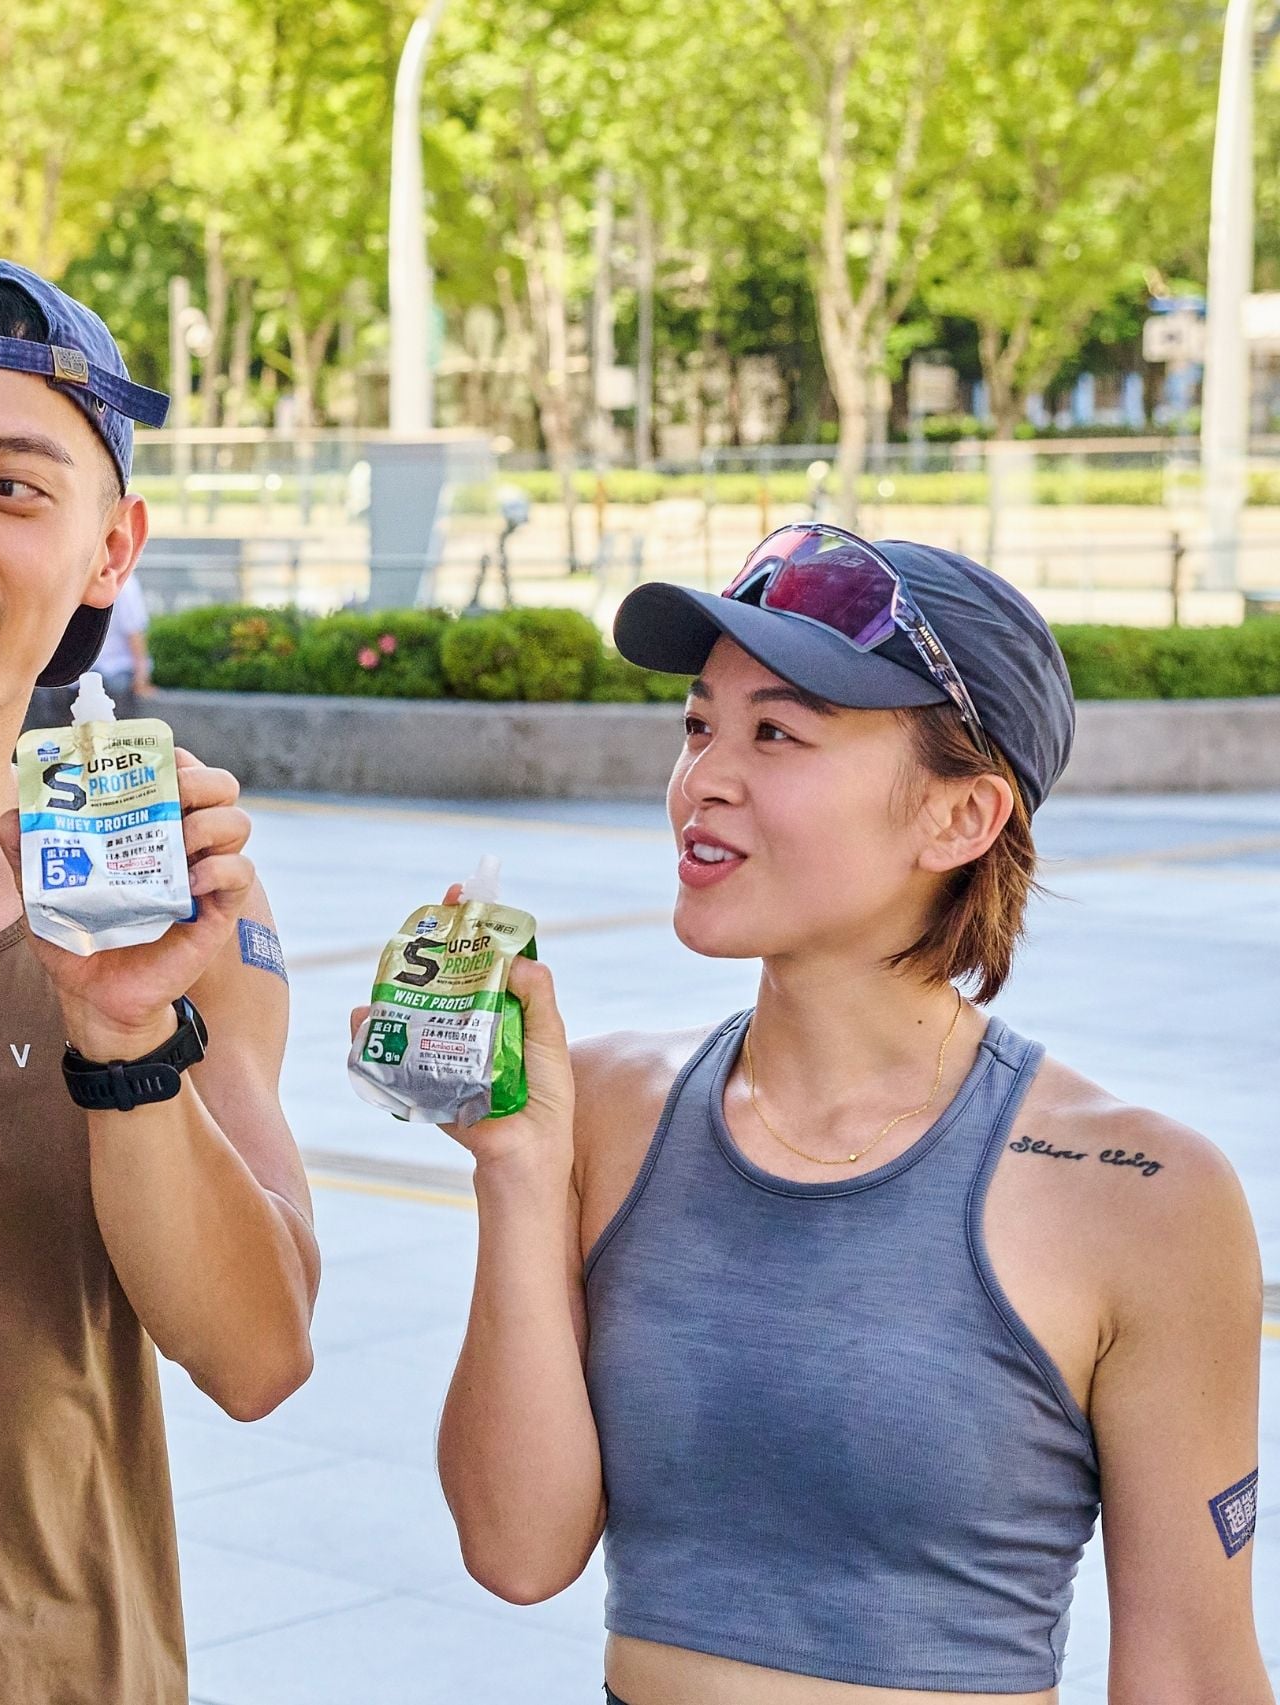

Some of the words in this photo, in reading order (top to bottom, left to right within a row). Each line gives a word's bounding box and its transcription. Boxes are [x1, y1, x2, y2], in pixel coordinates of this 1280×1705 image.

[89, 766, 156, 797] PROTEIN
[55, 816, 90, 833] WHEY
[96, 809, 149, 831] PROTEIN
[443, 951, 494, 975] PROTEIN
[393, 989, 428, 1007] WHEY
[430, 994, 475, 1010] PROTEIN
[373, 1021, 401, 1034] 蛋白質
[1225, 1484, 1257, 1535] 超能
